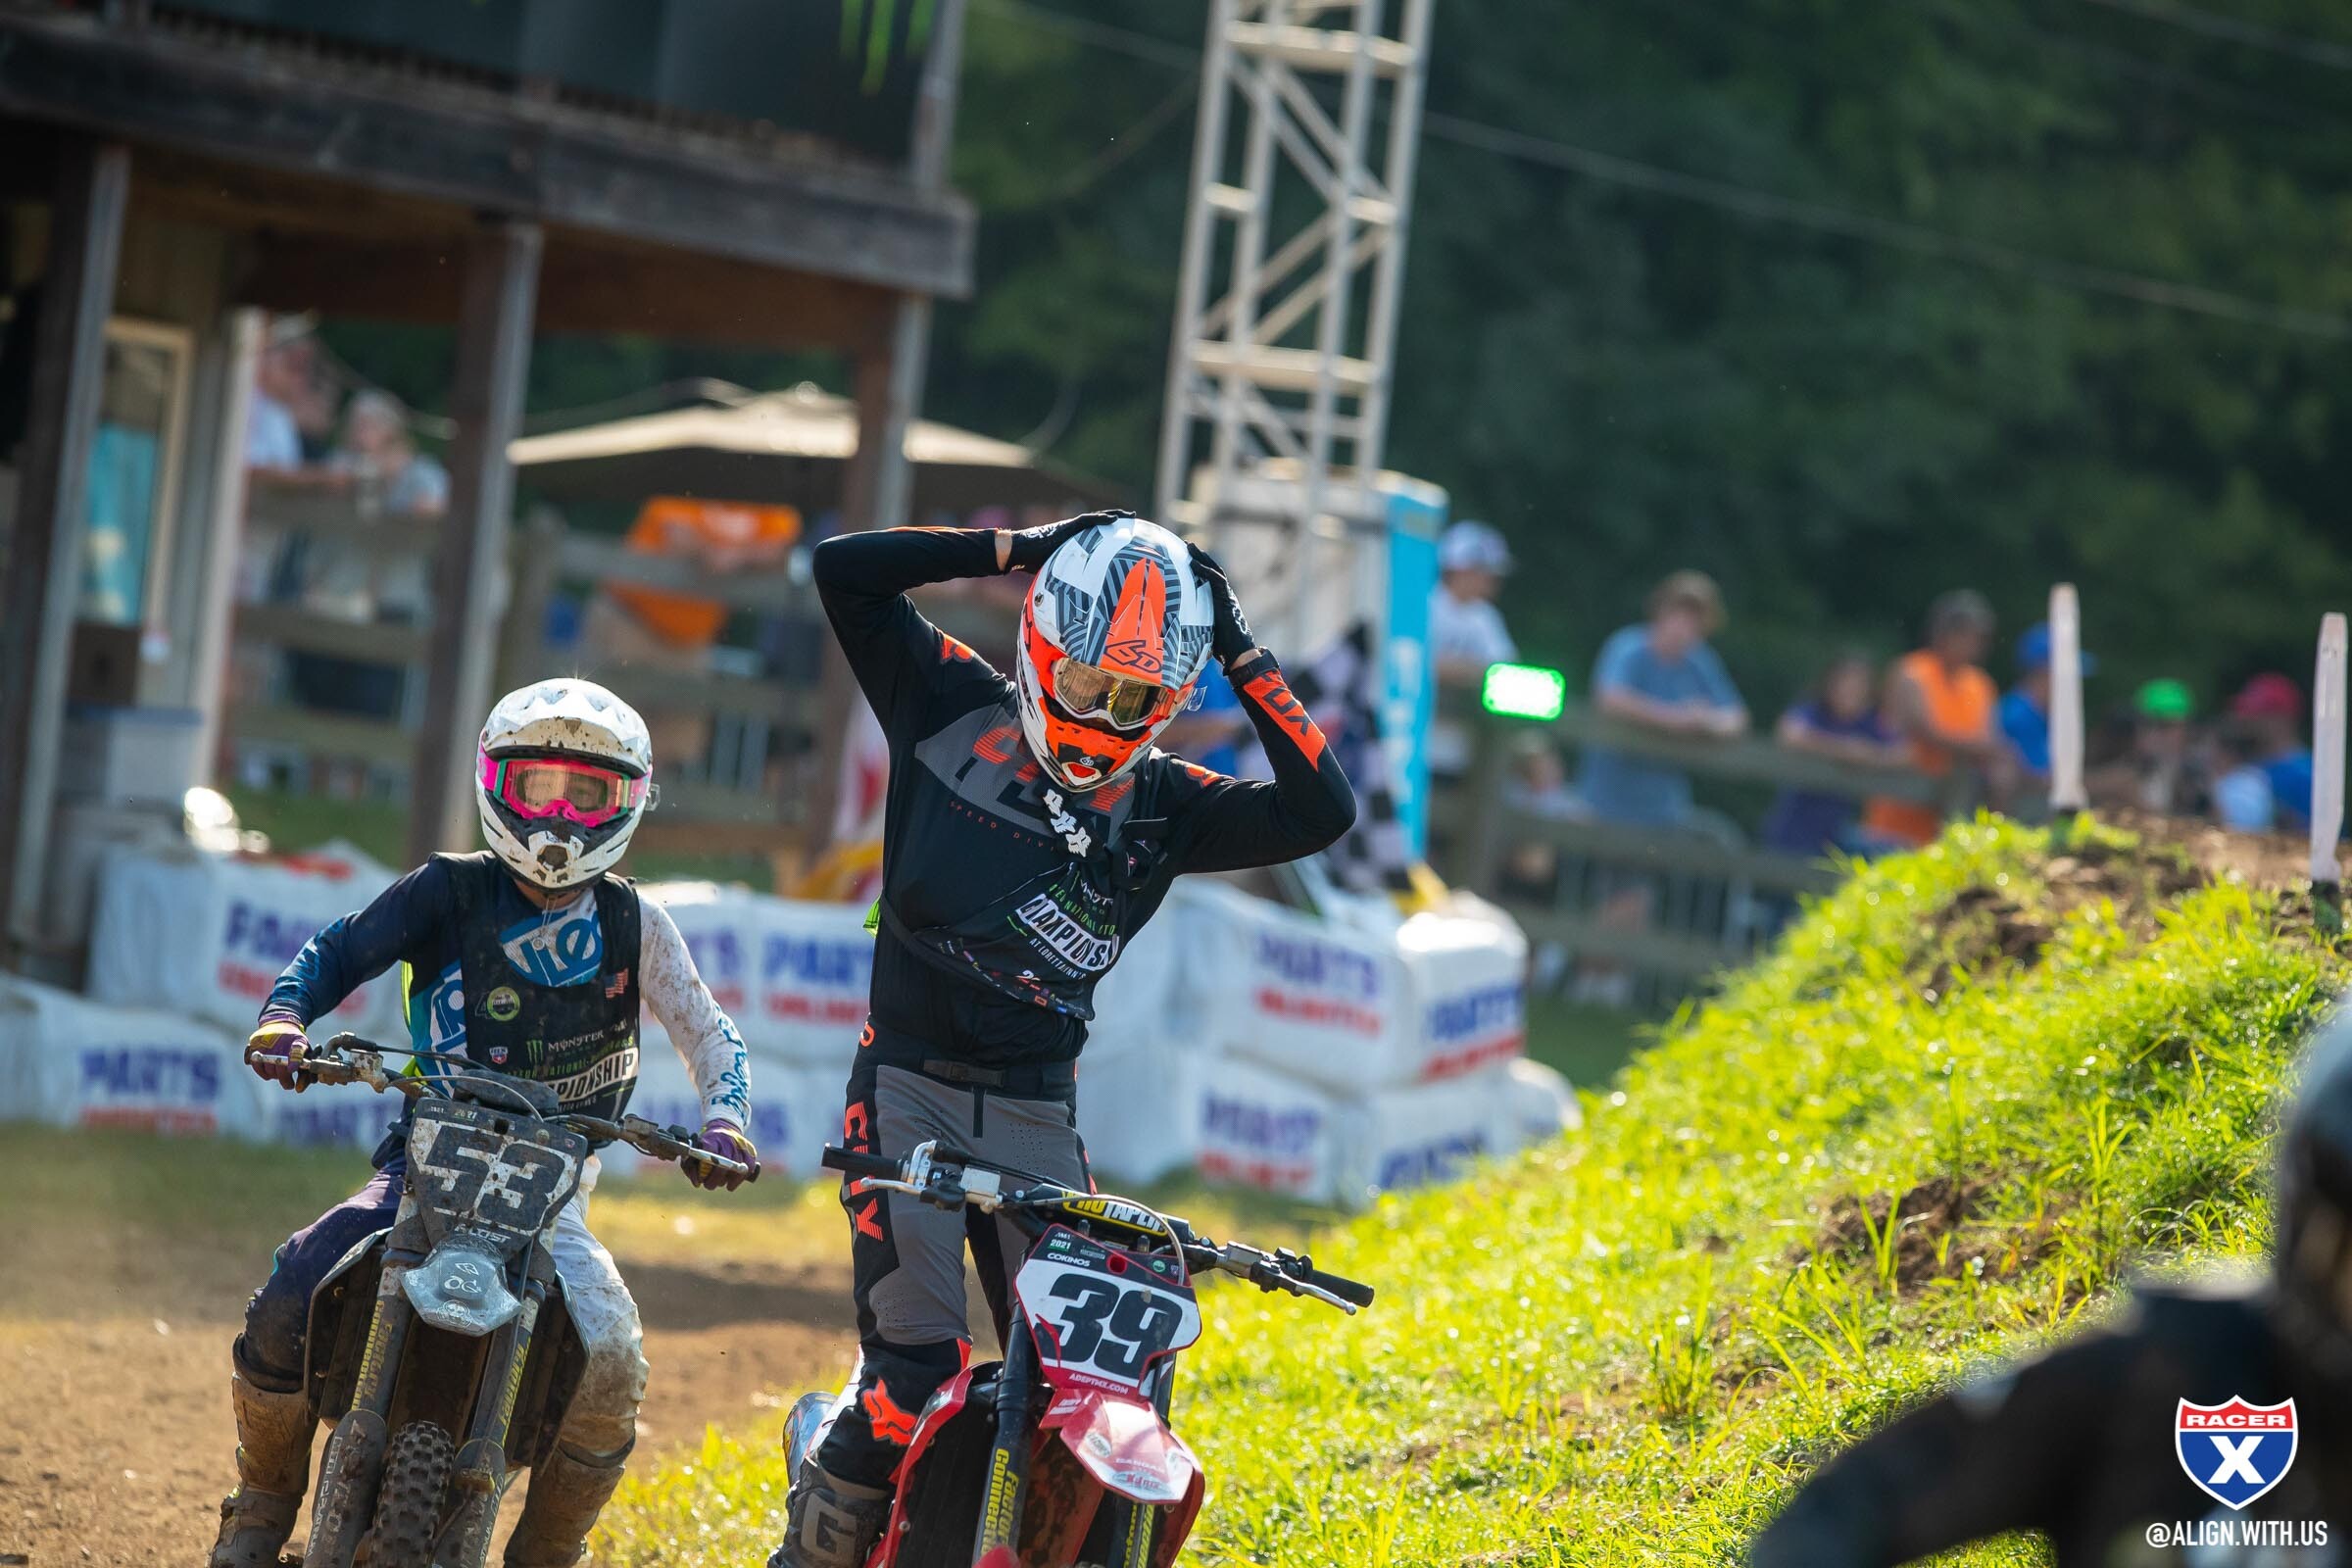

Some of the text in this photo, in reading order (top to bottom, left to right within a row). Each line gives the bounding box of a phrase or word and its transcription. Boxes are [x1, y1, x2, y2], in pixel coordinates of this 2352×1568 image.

[548, 1030, 605, 1053] MONSTER
[424, 1125, 565, 1232] 53
[1050, 1239, 1072, 1250] 2021
[1047, 1252, 1091, 1267] COKINOS
[1035, 1273, 1183, 1373] 39
[1068, 1373, 1129, 1395] ADEPTMX.COM
